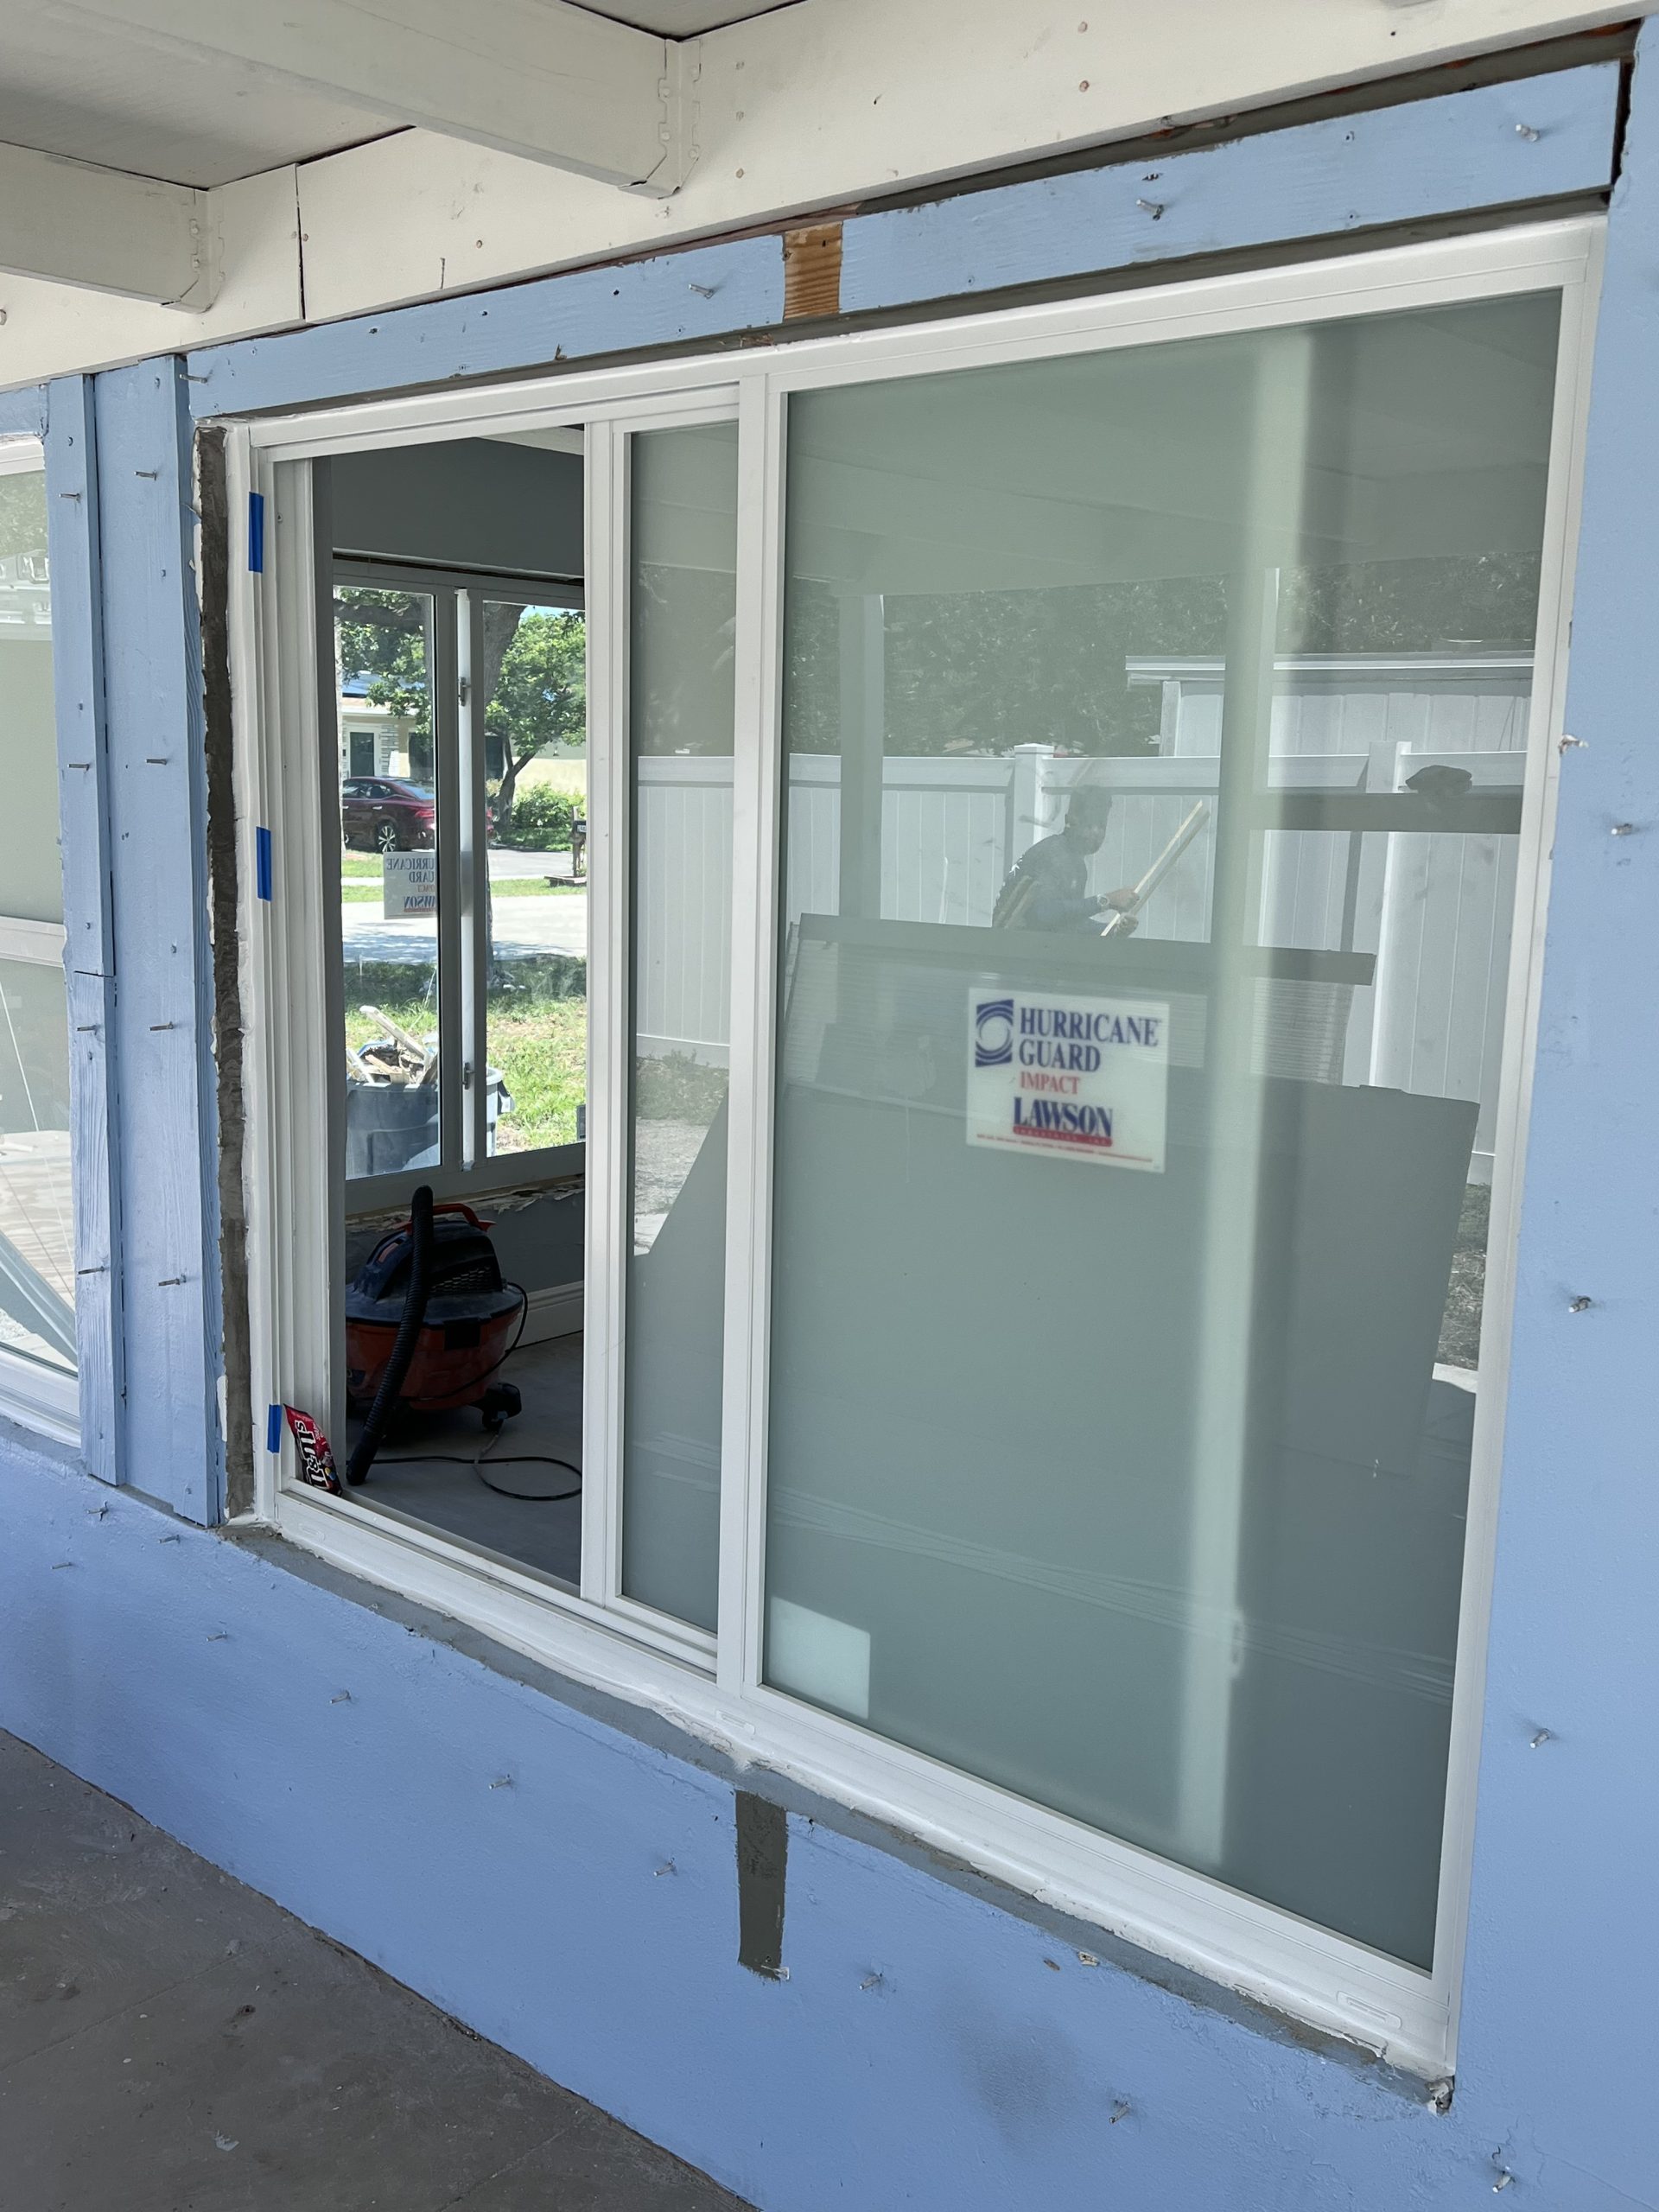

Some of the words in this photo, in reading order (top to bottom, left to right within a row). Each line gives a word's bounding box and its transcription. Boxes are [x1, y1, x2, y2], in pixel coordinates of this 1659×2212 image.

[1020, 1007, 1161, 1048] HURRICANE
[1019, 1039, 1101, 1072] GUARD
[1020, 1071, 1082, 1095] IMPACT
[1013, 1096, 1113, 1138] LAWSON
